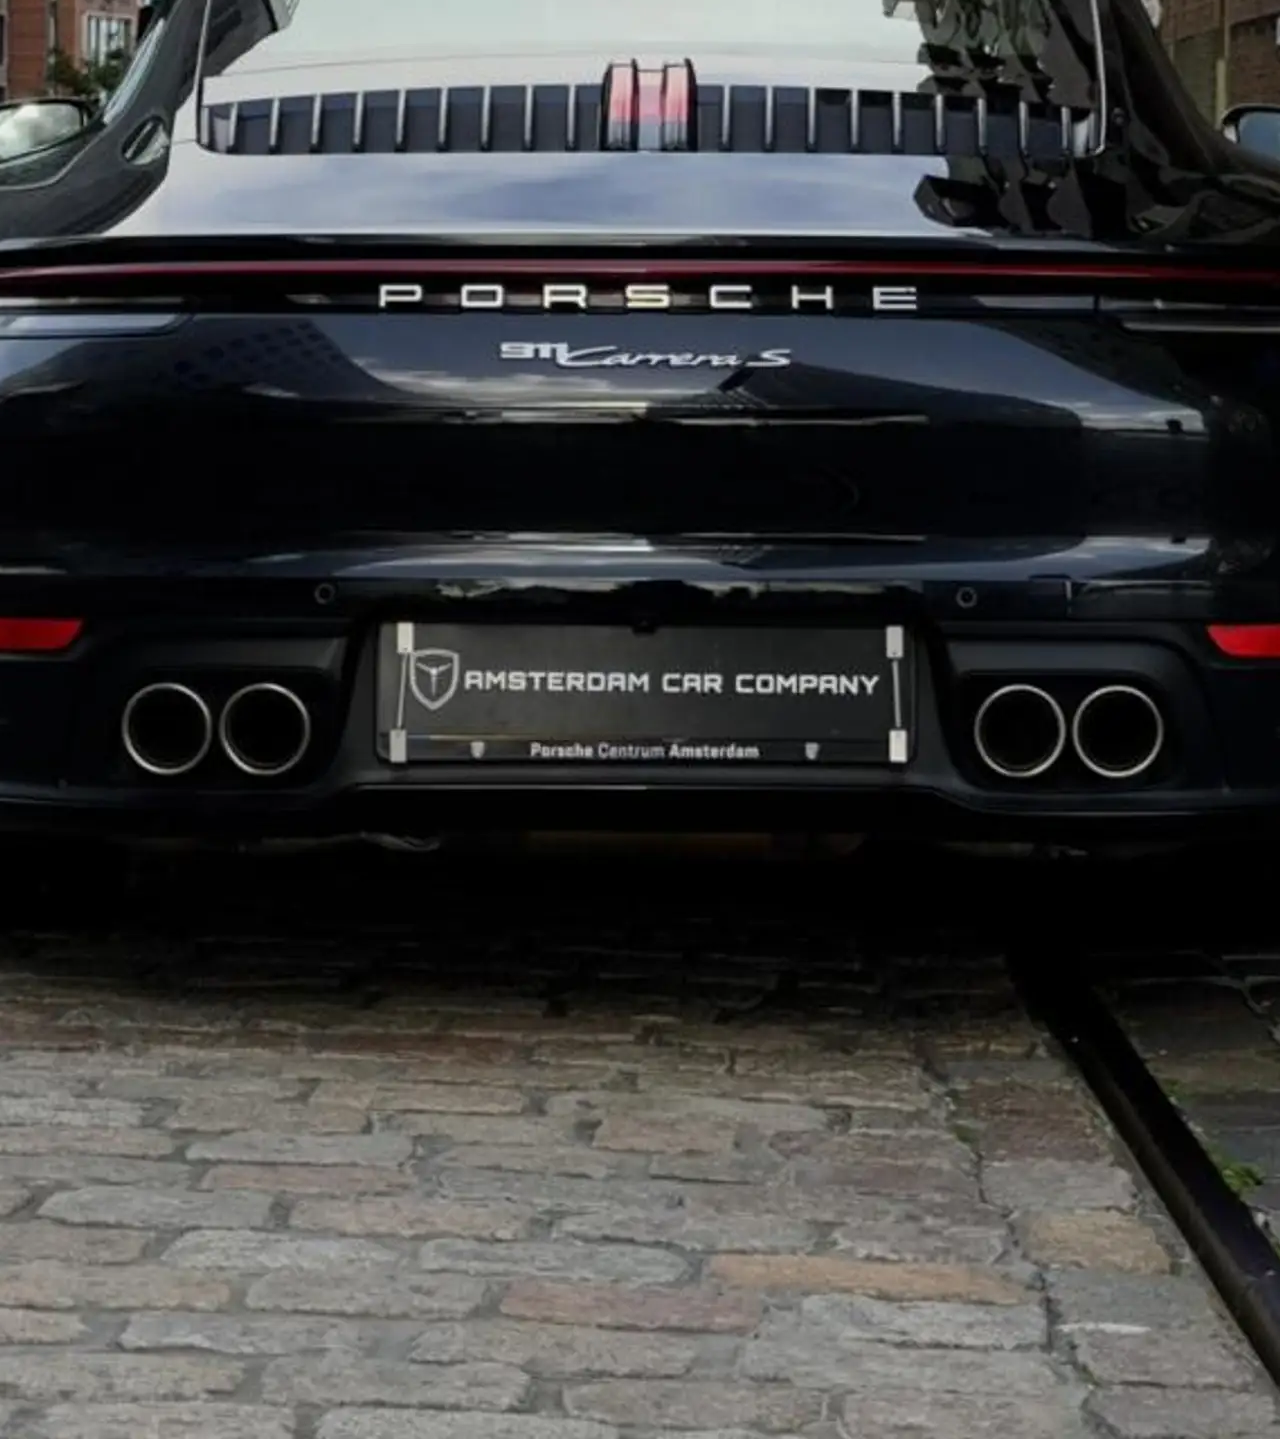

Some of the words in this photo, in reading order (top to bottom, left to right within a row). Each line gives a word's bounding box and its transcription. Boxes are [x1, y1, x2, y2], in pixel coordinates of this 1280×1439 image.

[378, 284, 919, 311] PORSCHE
[499, 341, 570, 361] 911
[557, 345, 744, 369] Carrera
[746, 348, 793, 368] S
[462, 670, 650, 694] AMSTERDAM
[661, 672, 723, 694] CAR
[735, 672, 880, 696] COMPANY
[530, 741, 594, 759] Porsche
[598, 742, 666, 759] Centrum
[668, 742, 760, 760] Amsterdam
